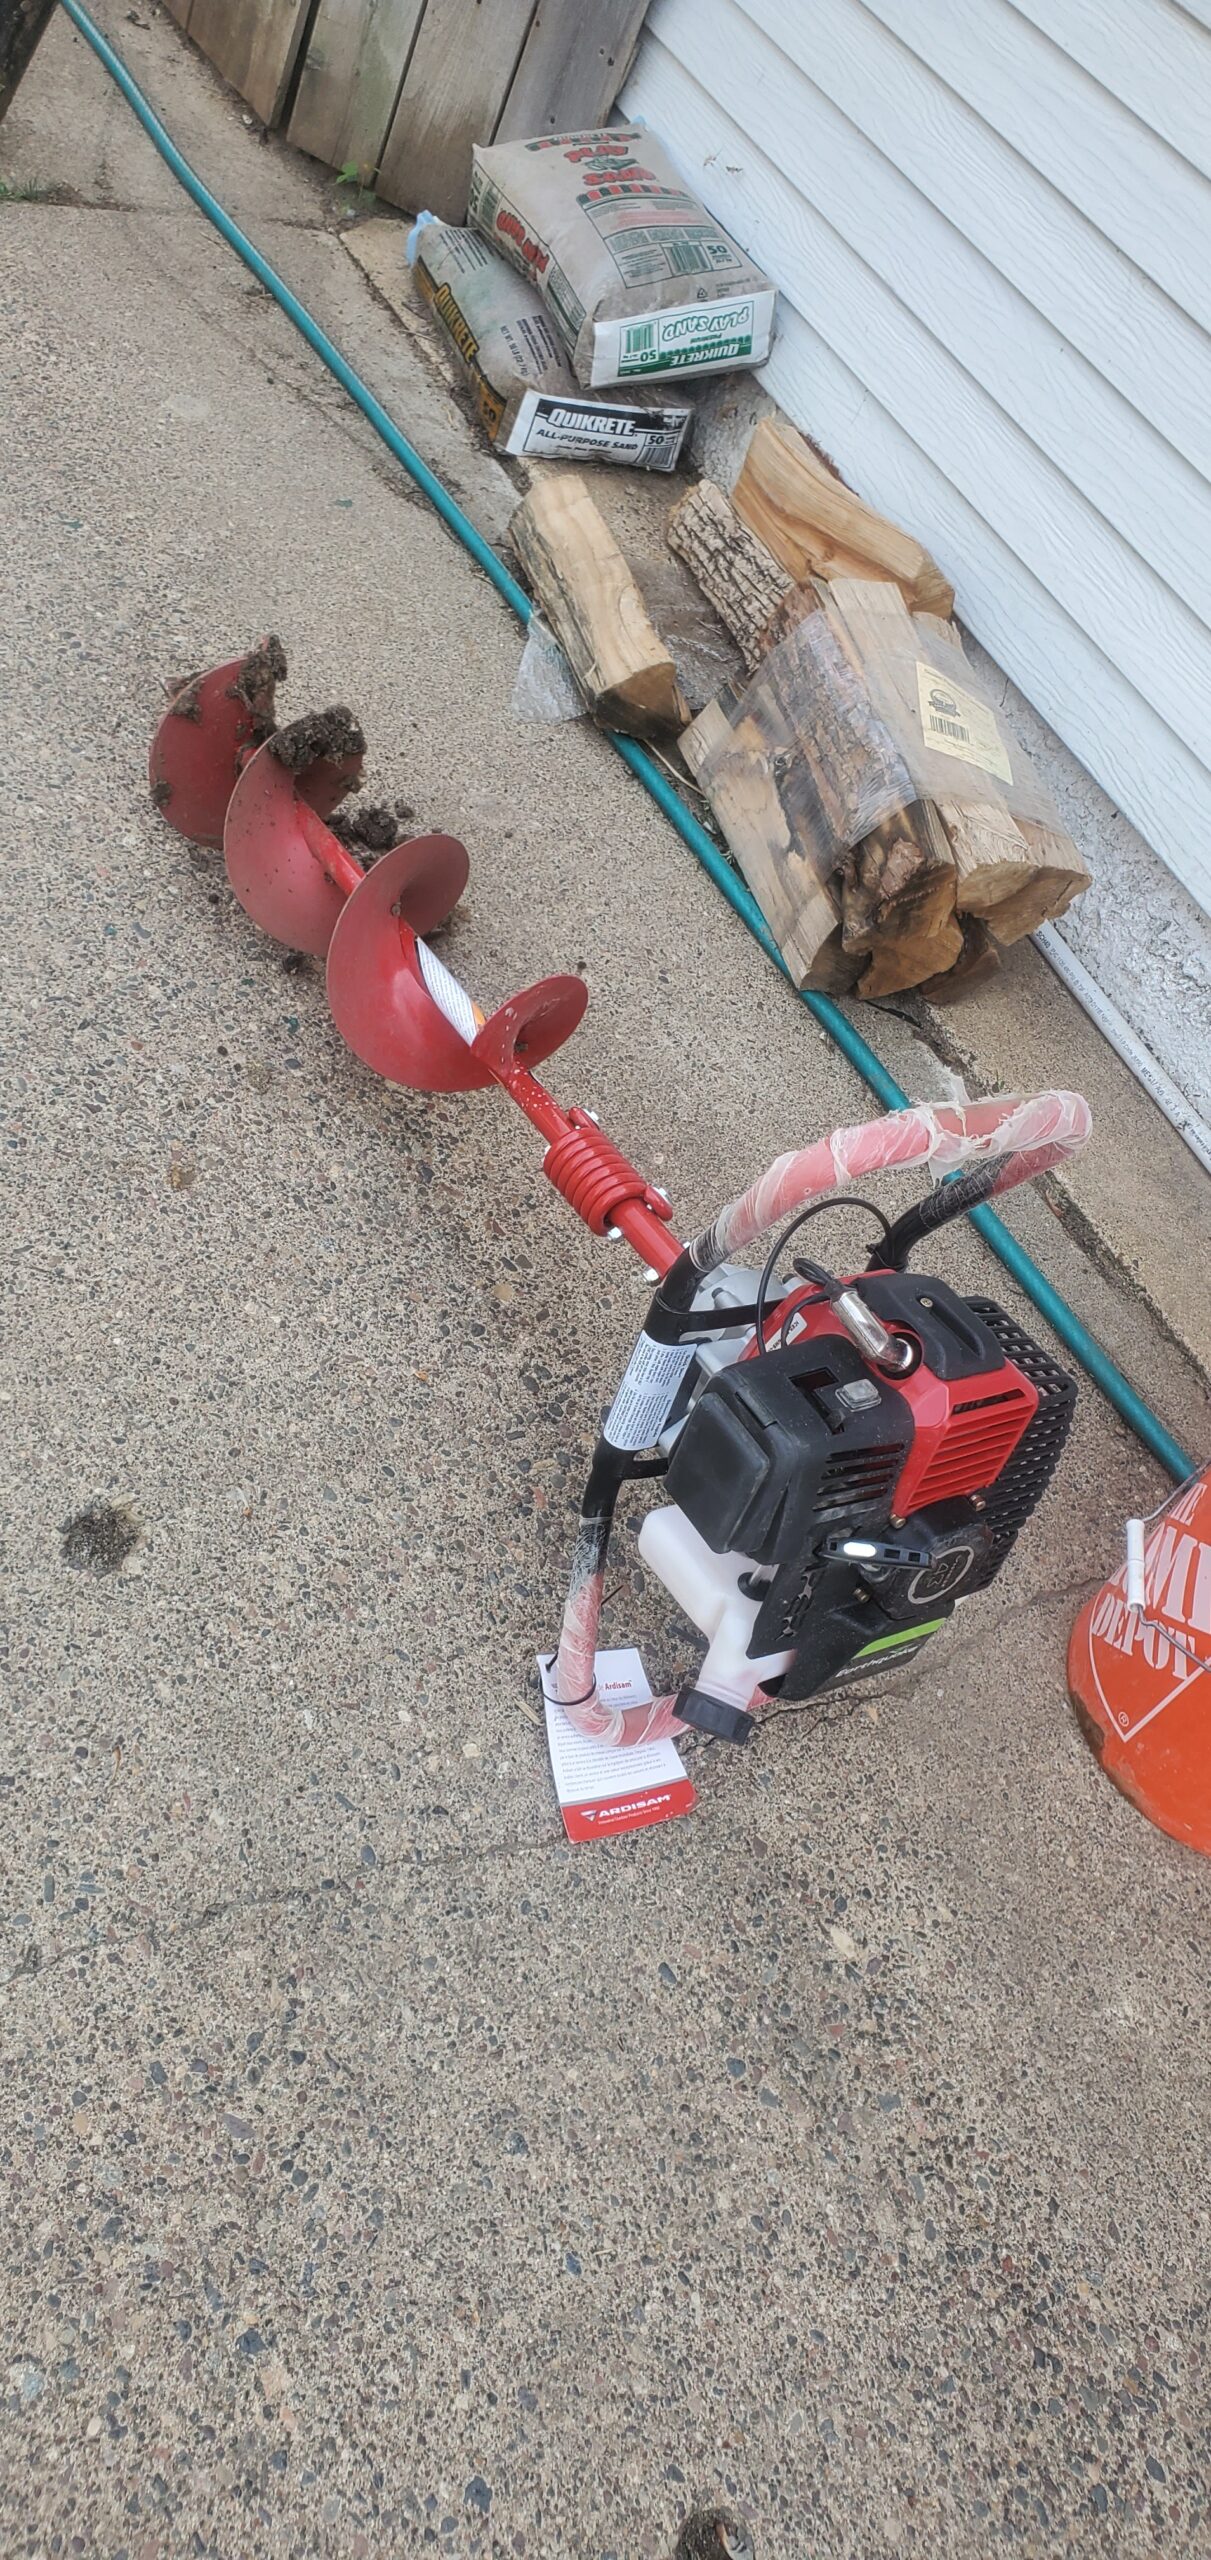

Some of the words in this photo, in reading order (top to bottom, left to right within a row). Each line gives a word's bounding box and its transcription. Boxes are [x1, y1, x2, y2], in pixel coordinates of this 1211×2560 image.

[706, 244, 727, 255] 50
[433, 285, 479, 363] QUIKRETE
[662, 317, 709, 341] SAND
[708, 307, 750, 330] PLAY
[639, 350, 657, 363] 50
[668, 343, 739, 366] QUIKRETE
[548, 409, 636, 436] QUIKRETE
[648, 436, 664, 445] 50
[1092, 1593, 1195, 1680] DEPOT
[605, 1680, 631, 1690] Ardisam
[599, 1794, 671, 1818] ARDISAM
